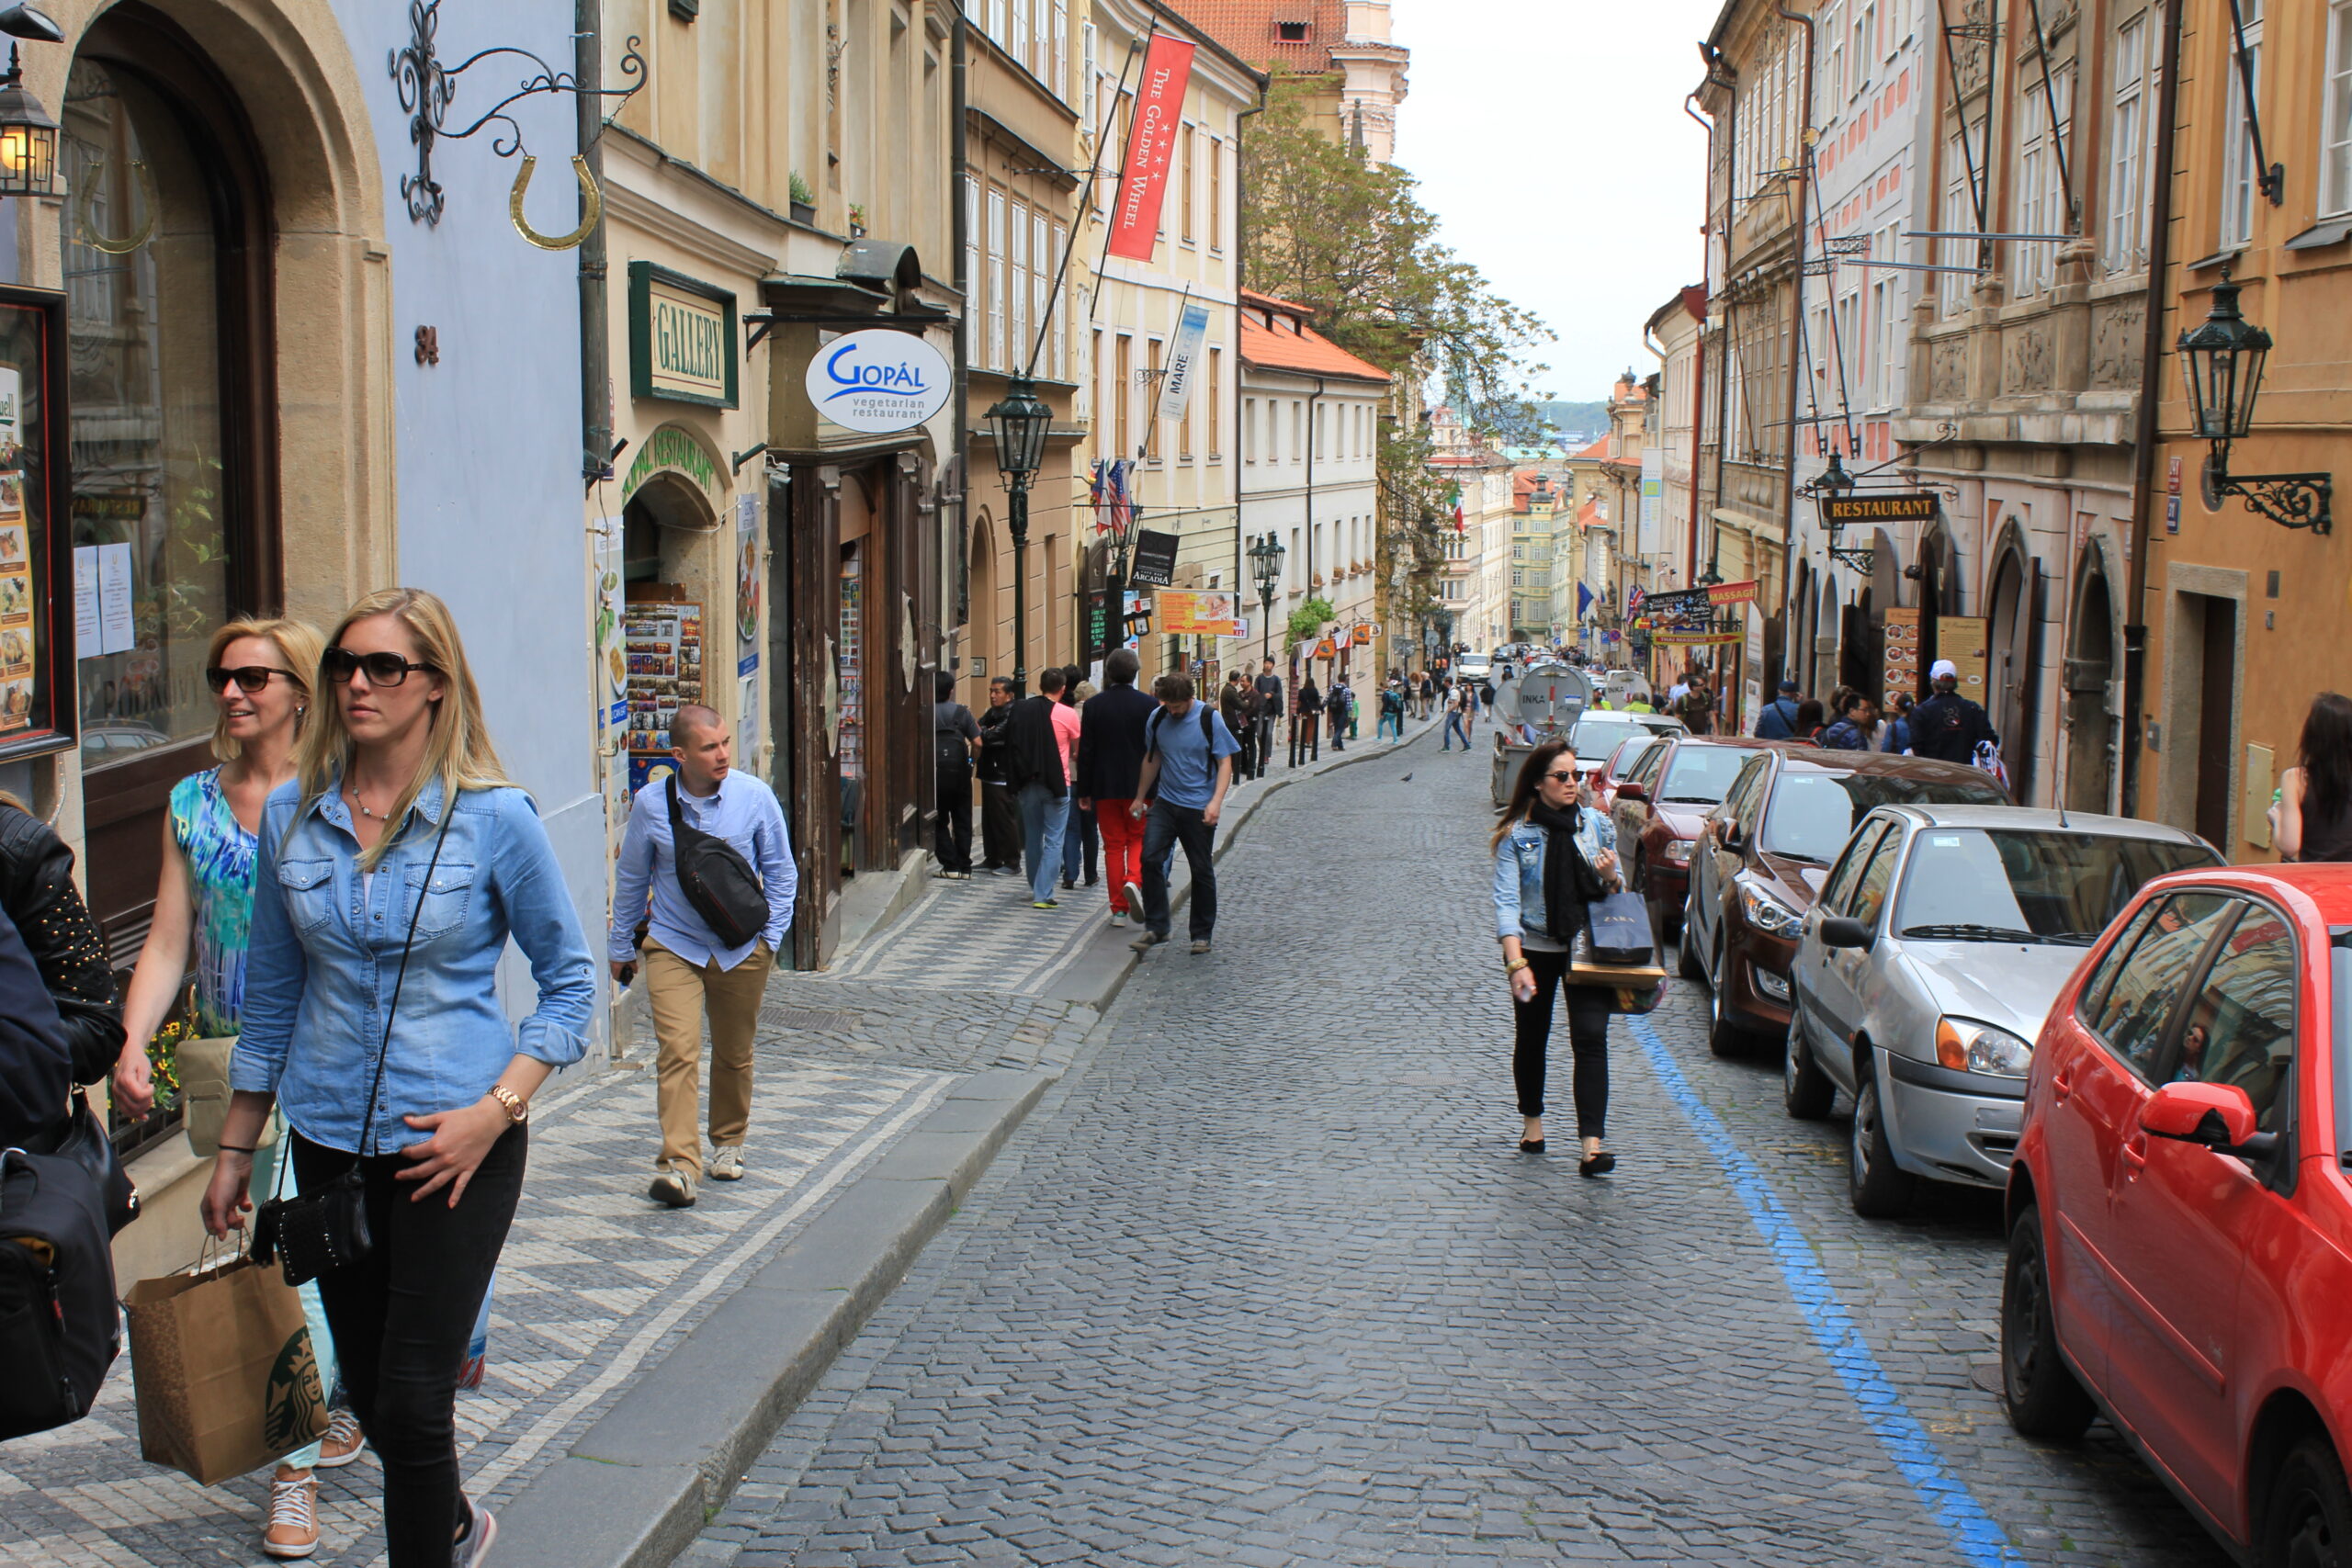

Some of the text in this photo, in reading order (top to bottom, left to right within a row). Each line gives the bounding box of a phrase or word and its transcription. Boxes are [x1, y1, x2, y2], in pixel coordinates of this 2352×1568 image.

[1123, 68, 1170, 229] THE GOLDEN WHEEL
[657, 302, 720, 380] GALLERY
[827, 343, 925, 387] GOPÁL
[1170, 354, 1189, 394] MARE
[853, 398, 925, 409] vegetarian
[853, 408, 923, 419] restaurant
[654, 431, 714, 495] RESTAURANT
[1831, 497, 1932, 519] RESTAURANT
[1133, 570, 1169, 585] ARCADIA
[1709, 588, 1755, 603] MASSAGE
[1522, 694, 1545, 704] INKA
[1603, 916, 1637, 924] ZARA
